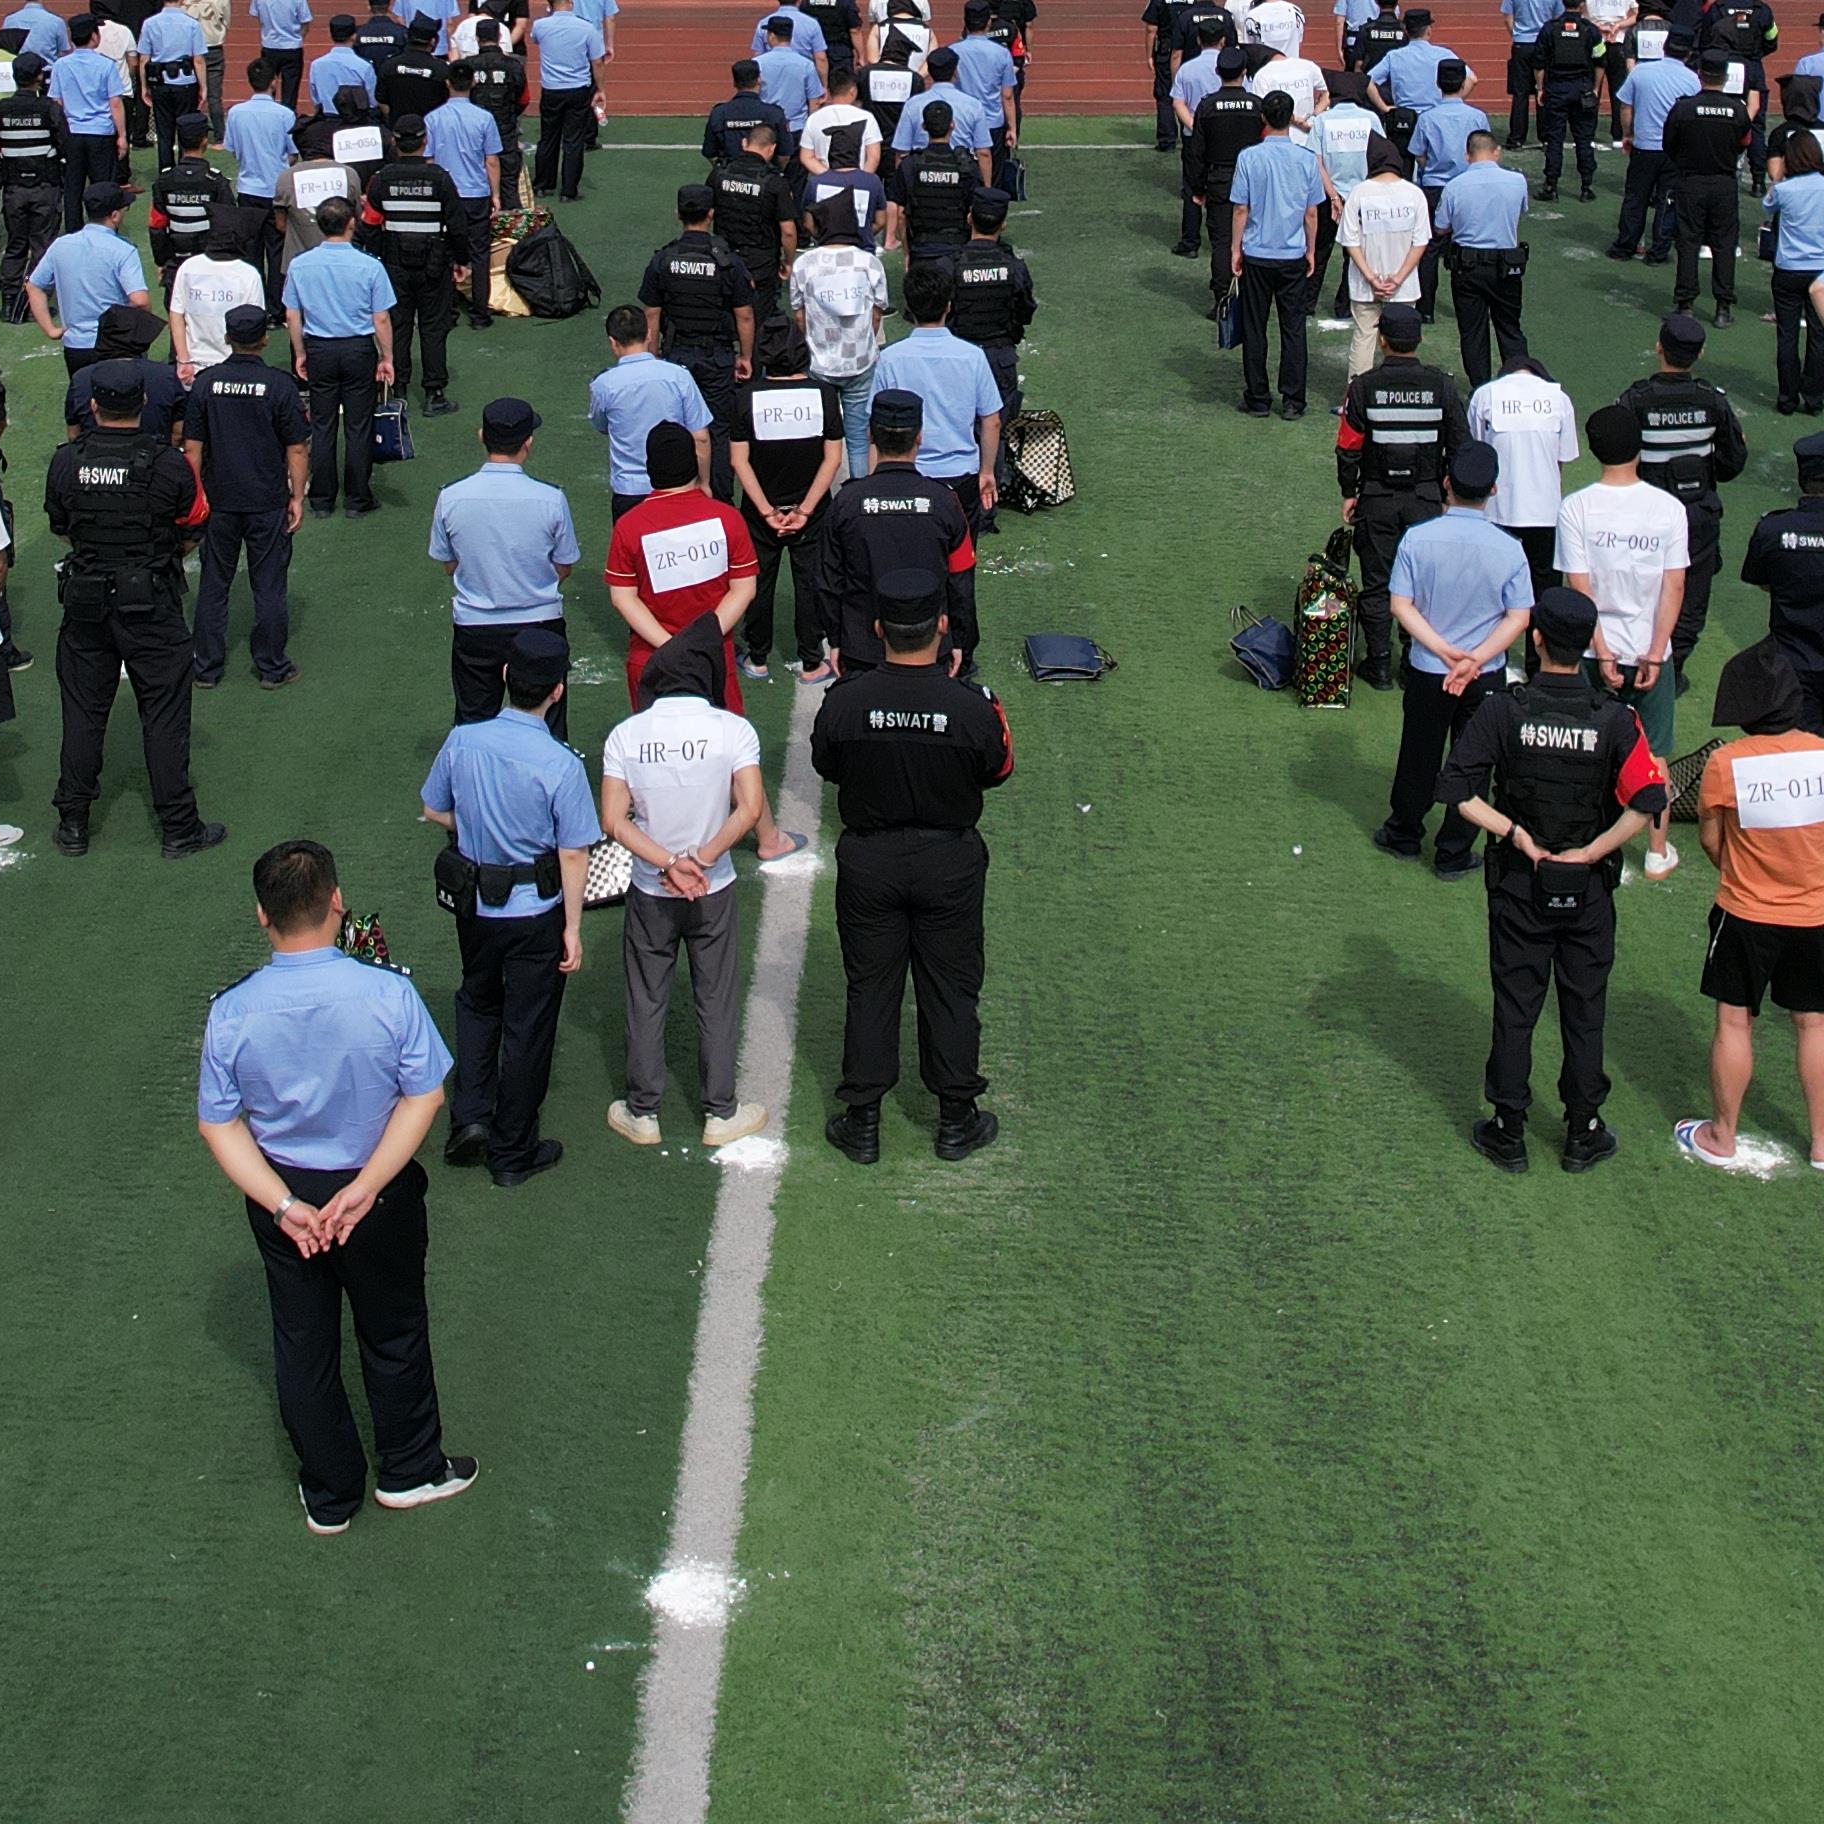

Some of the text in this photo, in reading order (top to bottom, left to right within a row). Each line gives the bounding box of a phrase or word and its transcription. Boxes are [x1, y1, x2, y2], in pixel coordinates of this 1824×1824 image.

[301, 180, 343, 194] FR-119
[1366, 207, 1411, 221] FR-113
[188, 288, 233, 303] FR-136
[763, 406, 812, 423] PR-01
[1502, 400, 1552, 415] HR-03
[79, 466, 129, 485] 特SWAT
[1595, 531, 1660, 552] ZR-009
[656, 539, 720, 570] ZR-010
[639, 739, 709, 764] HR-07
